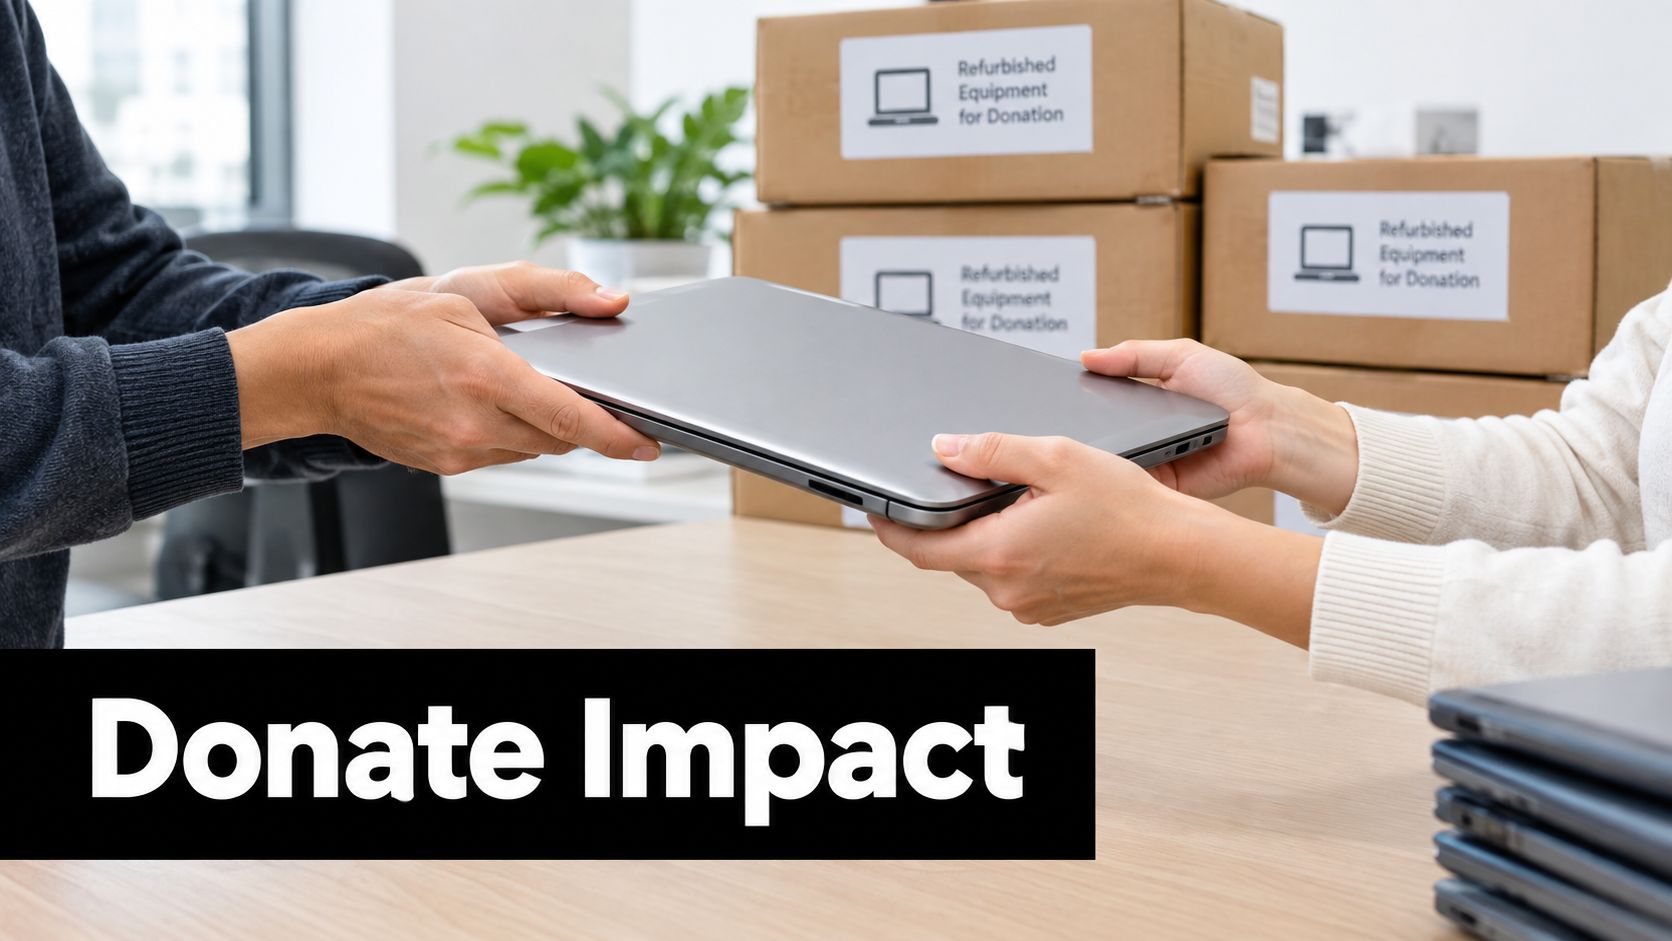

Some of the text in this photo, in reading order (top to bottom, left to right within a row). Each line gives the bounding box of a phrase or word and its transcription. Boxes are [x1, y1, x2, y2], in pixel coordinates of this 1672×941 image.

[958, 56, 1056, 76] Refurbished
[958, 83, 1048, 103] Equipment
[959, 106, 1064, 125] for Donation
[1379, 221, 1473, 238] Refurbished
[1380, 245, 1465, 264] Equipment
[961, 265, 1059, 282] Refurbished
[1379, 270, 1480, 288] for Donation
[962, 290, 1052, 308] Equipment
[961, 315, 1067, 331] for Donation
